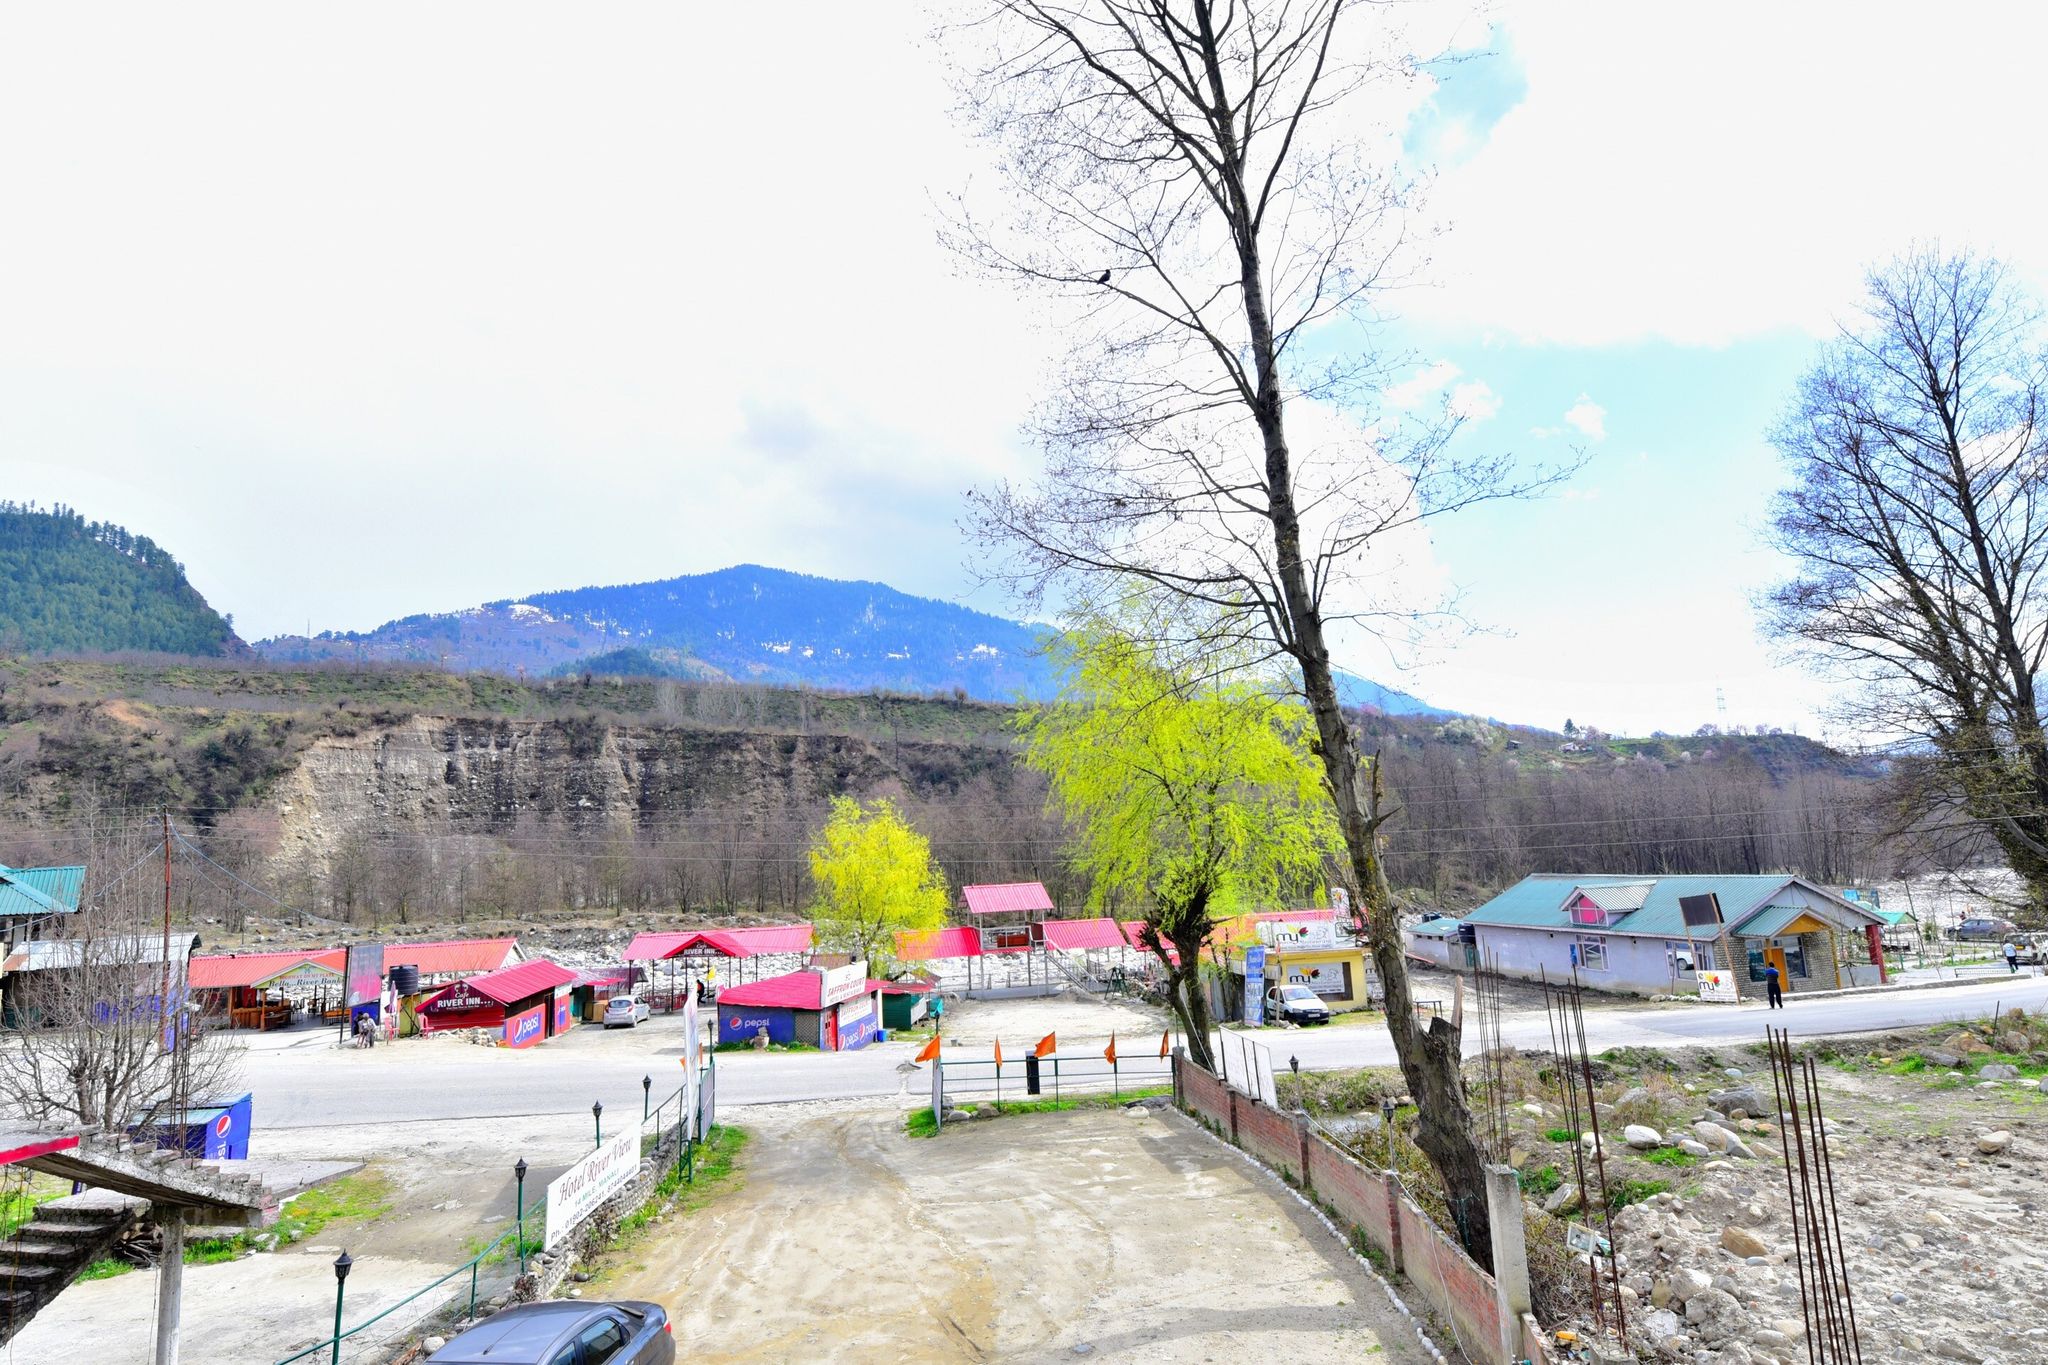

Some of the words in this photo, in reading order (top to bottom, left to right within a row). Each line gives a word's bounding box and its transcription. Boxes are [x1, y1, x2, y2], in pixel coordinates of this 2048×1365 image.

[828, 983, 850, 997] SAFFRON
[850, 976, 865, 989] COURT
[1290, 974, 1310, 984] my
[437, 999, 464, 1008] RIVER
[522, 1012, 539, 1037] pepsi
[745, 1018, 770, 1028] pepsi
[865, 1018, 877, 1036] pepsi
[846, 1029, 859, 1047] pepsi
[558, 1162, 587, 1206] Hotel
[587, 1152, 612, 1182] River
[613, 1137, 634, 1160] View
